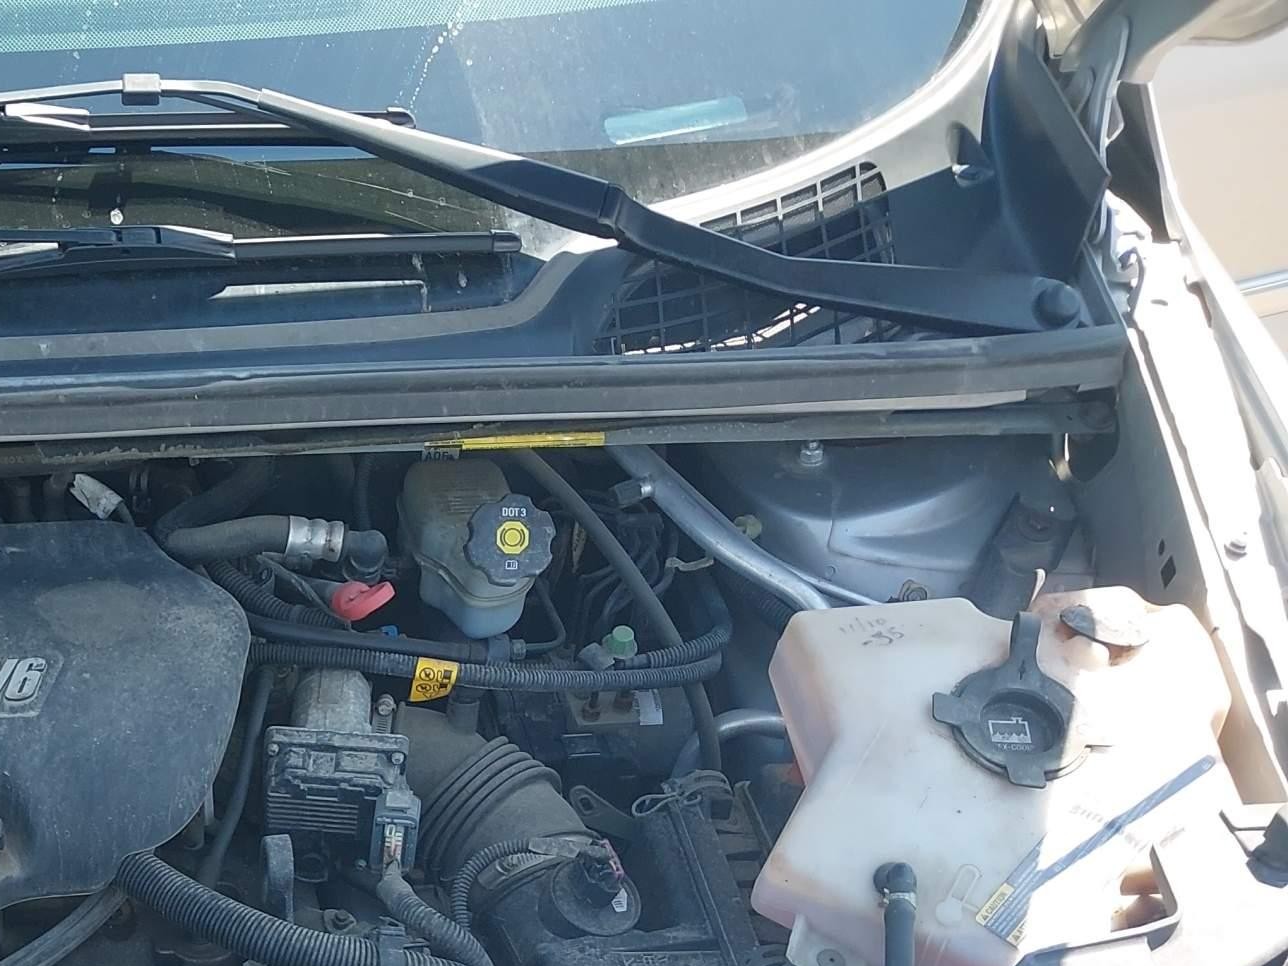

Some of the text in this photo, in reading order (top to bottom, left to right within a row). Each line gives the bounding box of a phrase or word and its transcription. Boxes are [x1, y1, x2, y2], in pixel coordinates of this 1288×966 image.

[502, 507, 527, 517] DOT 3
[986, 890, 1010, 915] CAUTION
